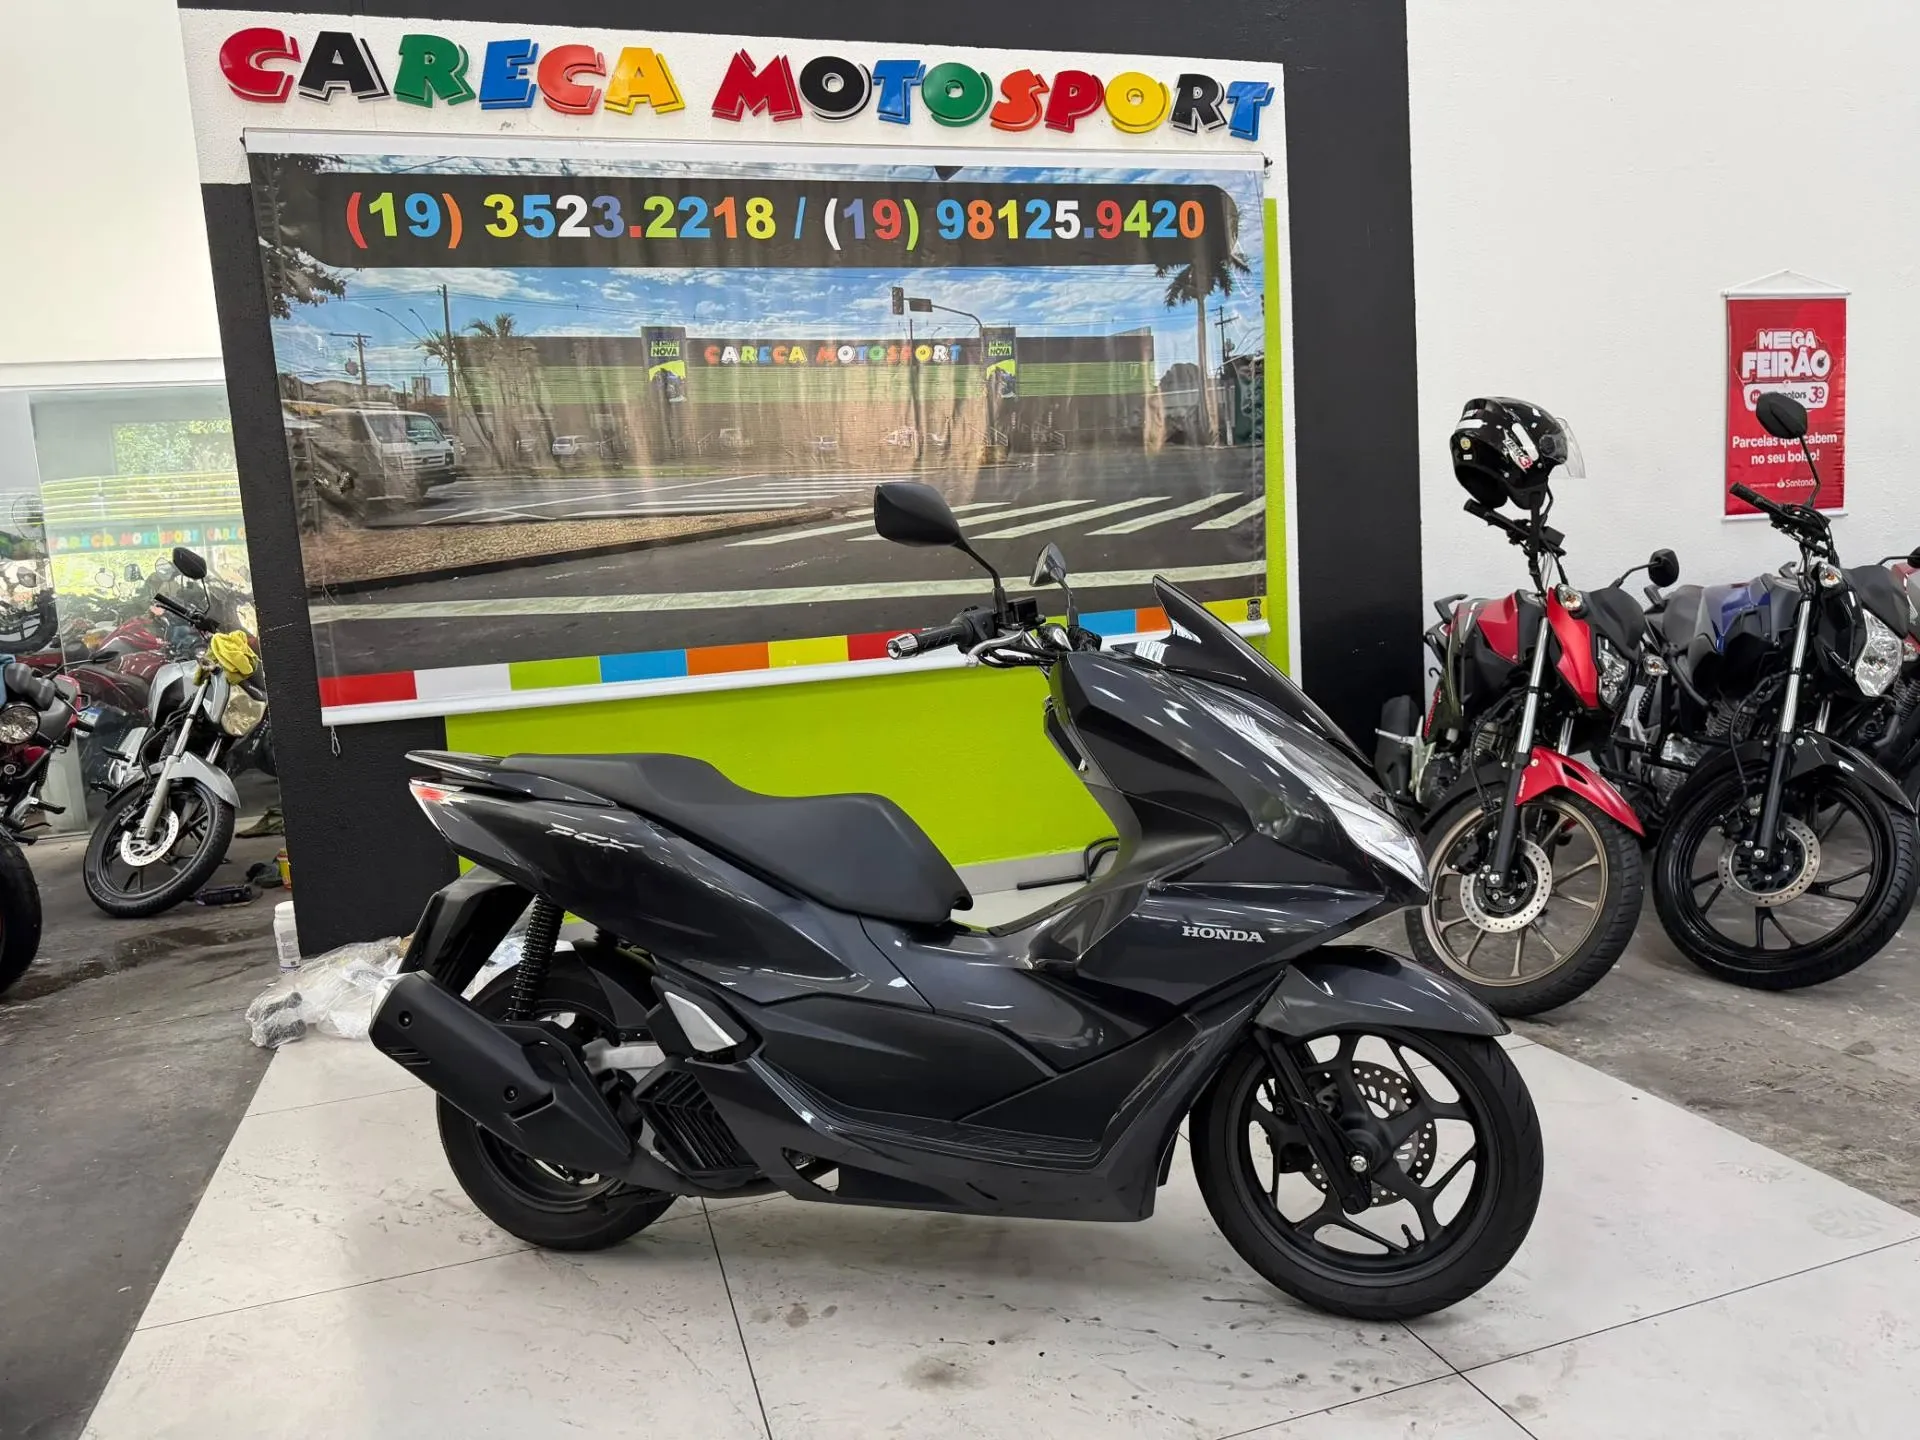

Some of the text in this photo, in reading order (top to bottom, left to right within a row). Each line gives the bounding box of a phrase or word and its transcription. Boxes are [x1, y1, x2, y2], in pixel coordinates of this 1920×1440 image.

[219, 27, 1276, 141] CARECA MOTOSPORT
[346, 191, 464, 249] (19)
[483, 193, 777, 240] 3523.2218
[824, 197, 920, 251] (19)
[936, 199, 1205, 241] 98125.9420
[1758, 330, 1816, 350] MEGA
[704, 344, 962, 365] CARECA MOTOSPORT
[1742, 346, 1830, 379] FEIRÃO
[1732, 434, 1779, 448] Parcelas
[1751, 454, 1765, 465] no
[1767, 453, 1786, 464] seu
[1182, 926, 1266, 943] HONDA
